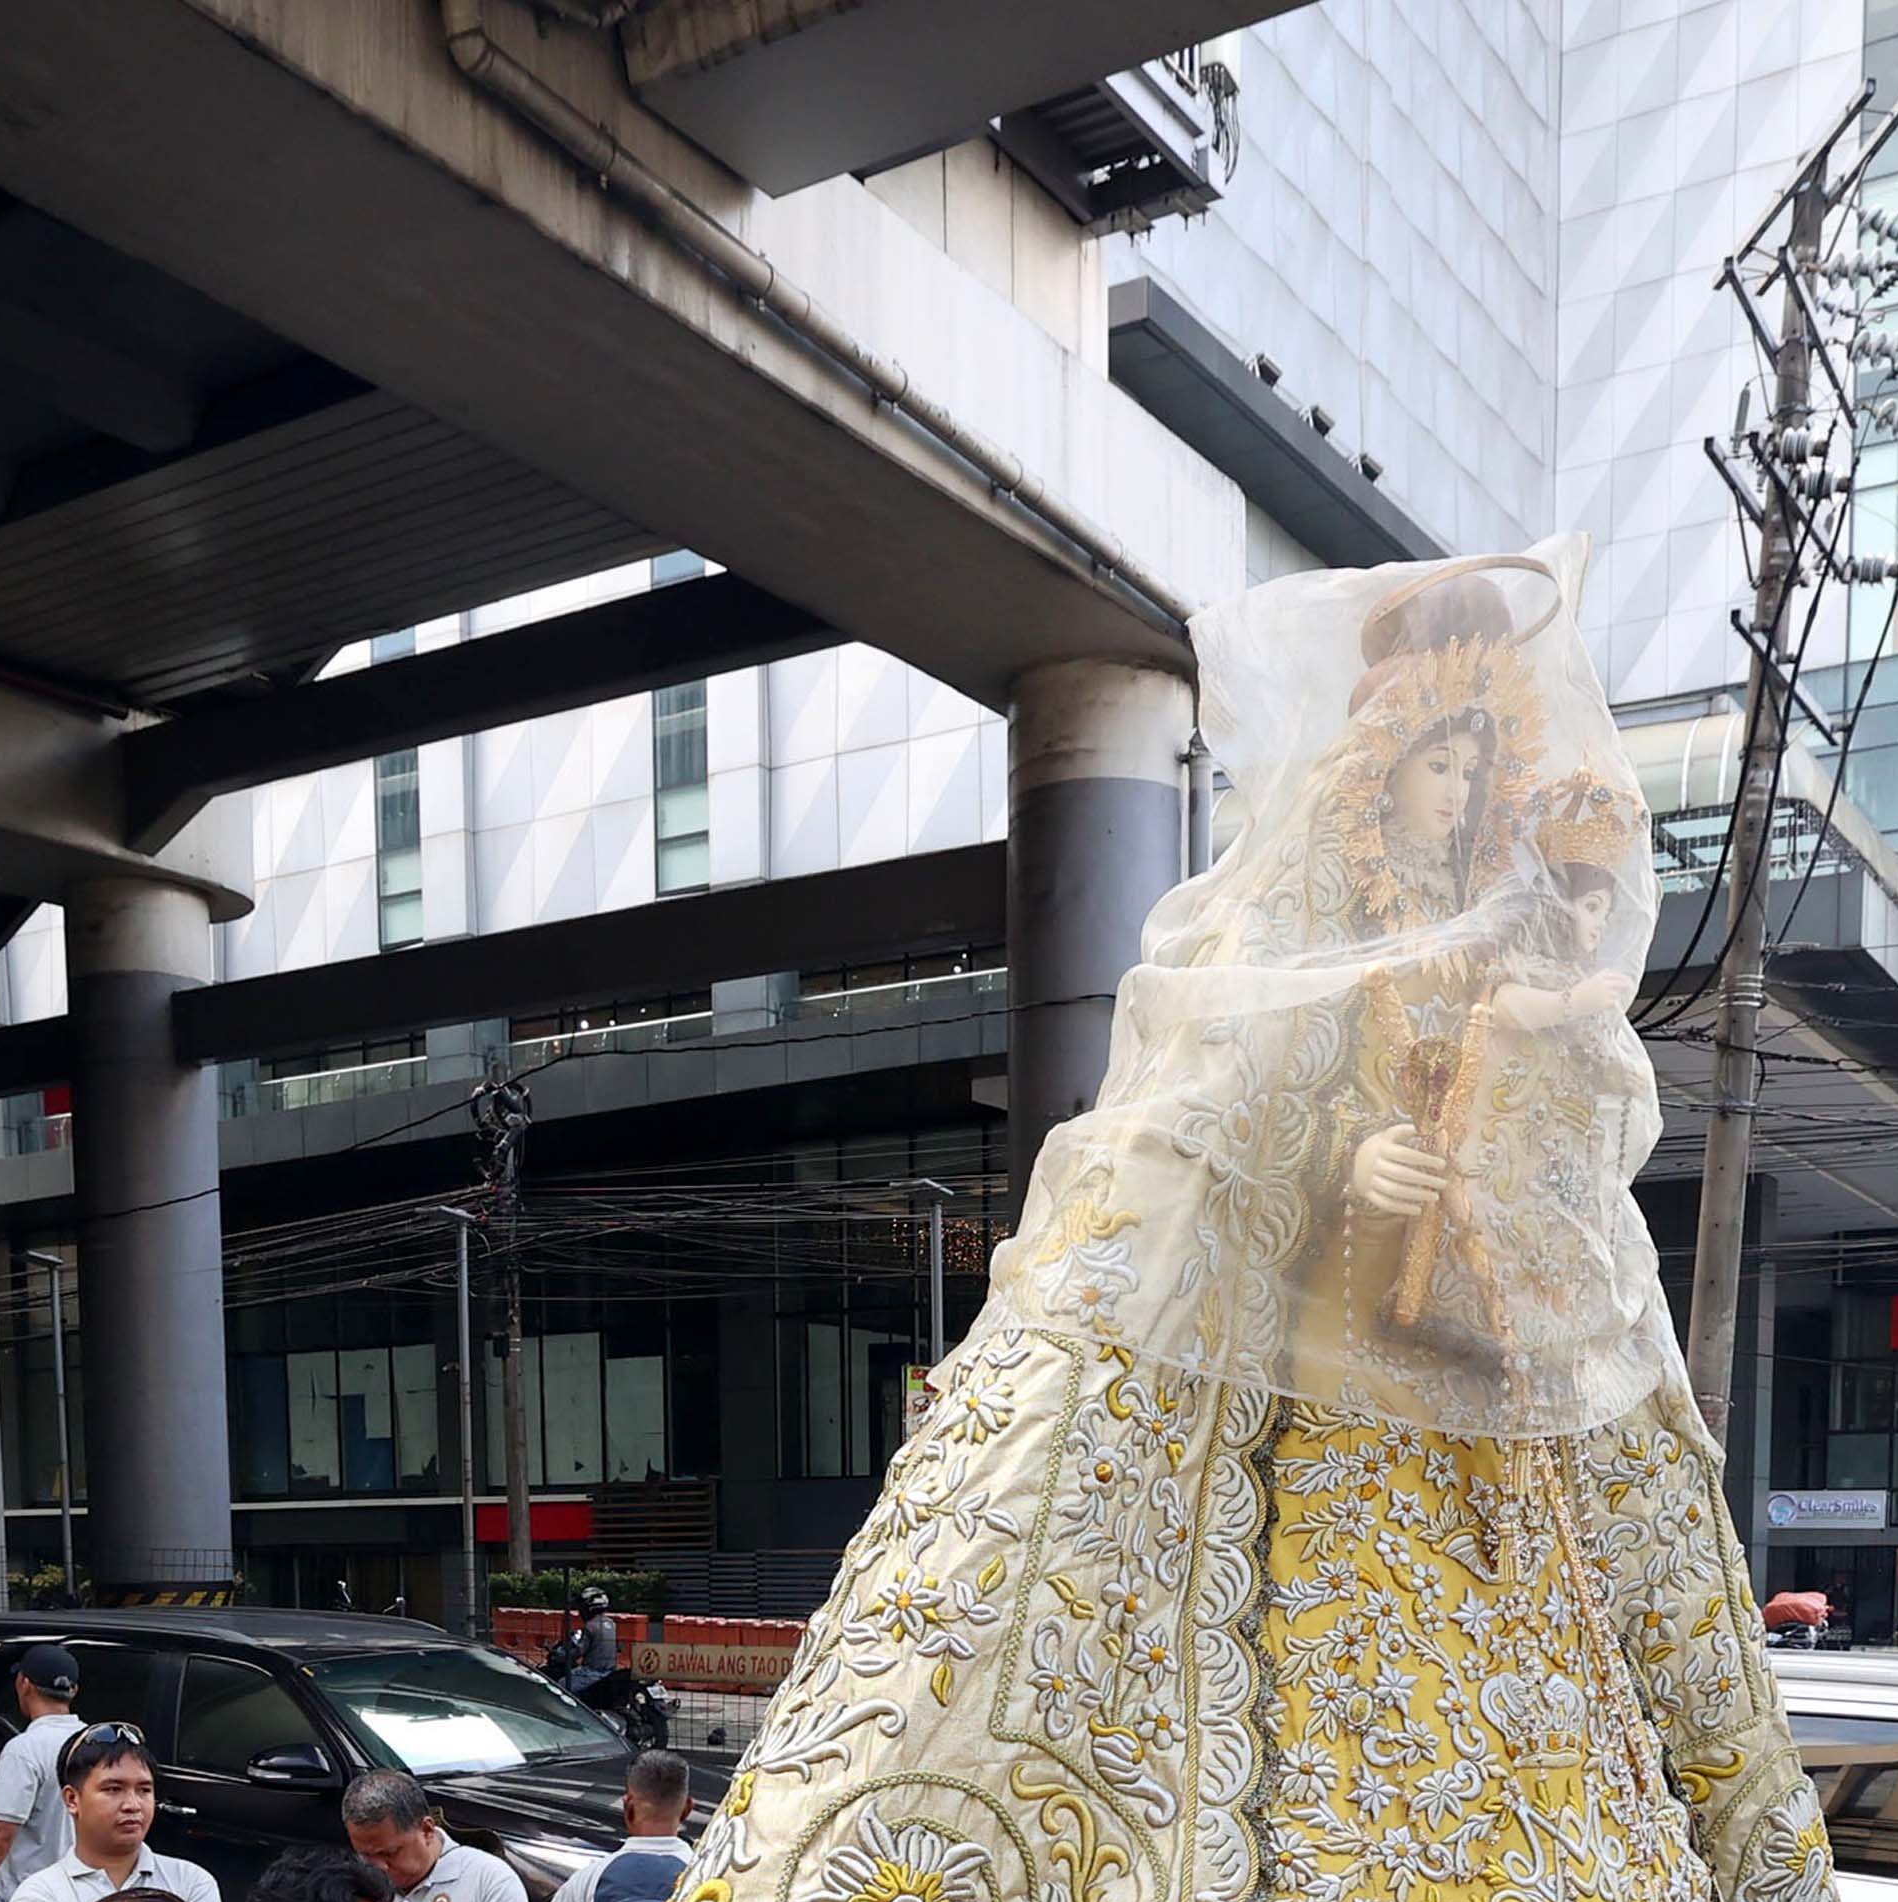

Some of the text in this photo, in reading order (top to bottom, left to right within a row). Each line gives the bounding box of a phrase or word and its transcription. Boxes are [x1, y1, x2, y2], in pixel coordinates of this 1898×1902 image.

[1798, 1498, 1878, 1514] ClearSmiles
[668, 1653, 713, 1675] BAWAL
[718, 1655, 746, 1676] ANG
[751, 1656, 777, 1676] TAO
